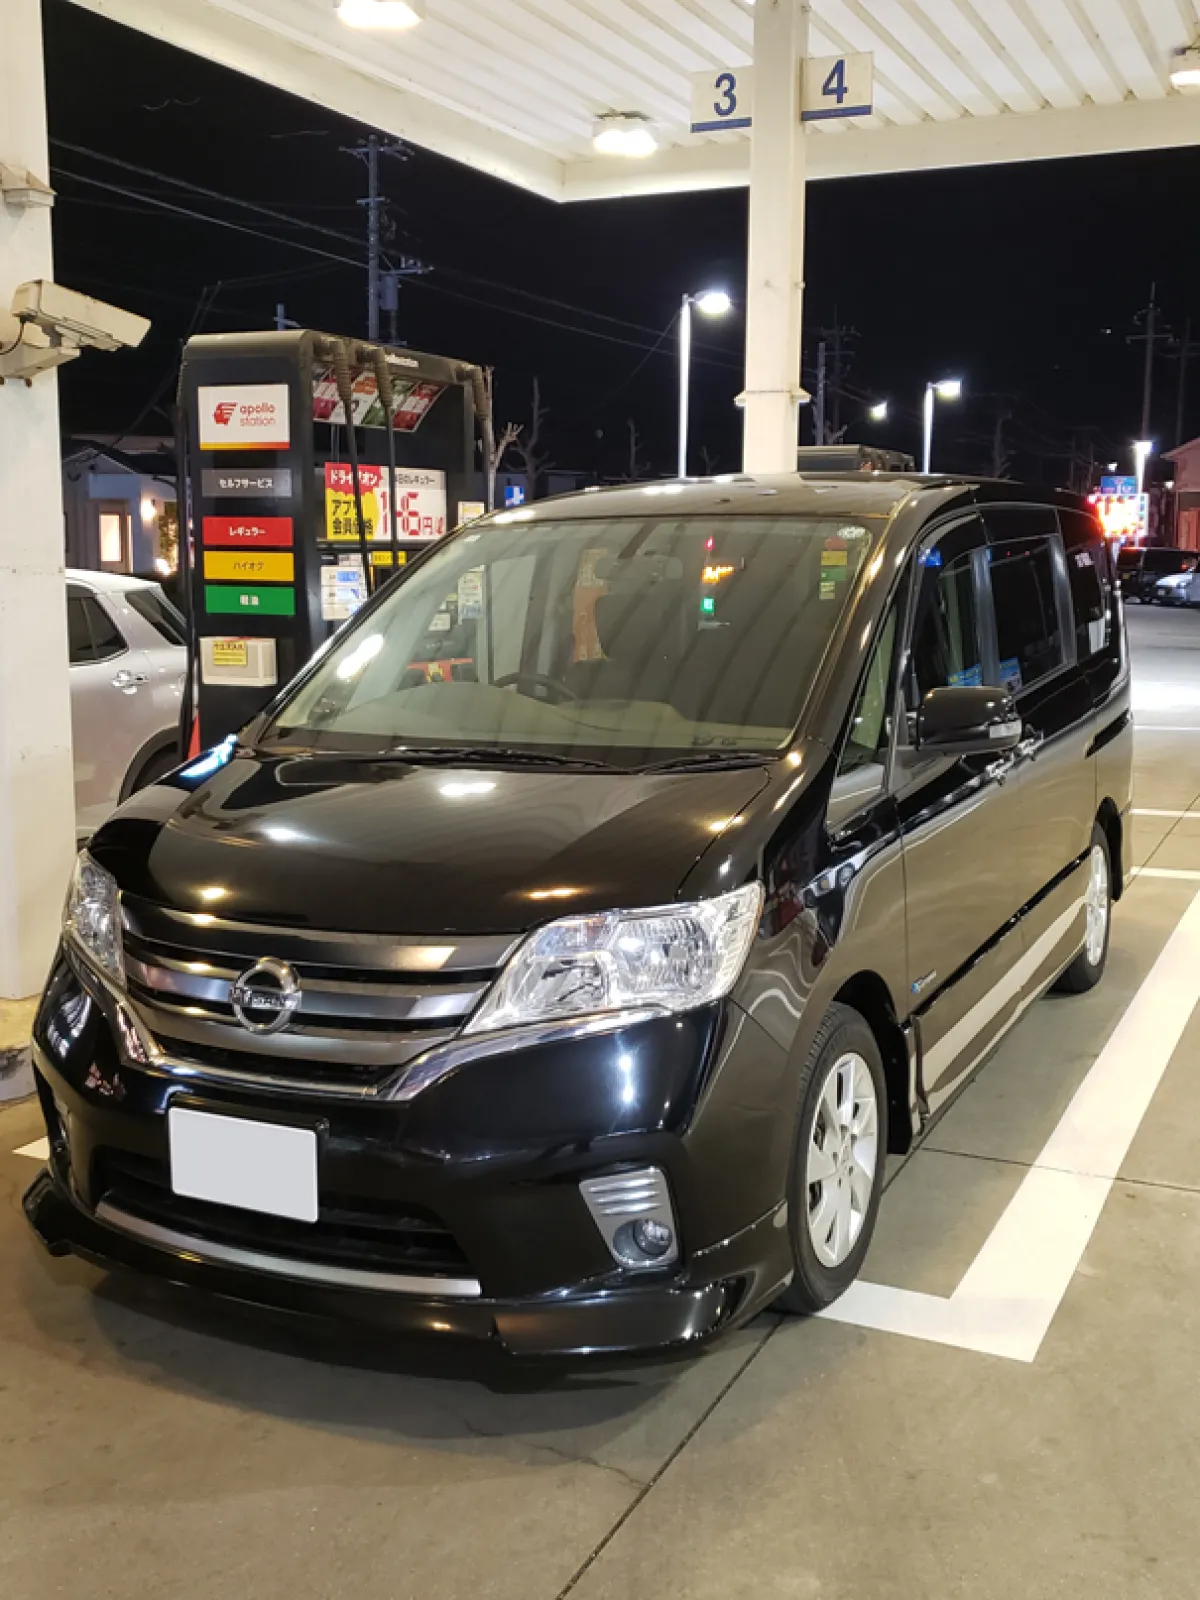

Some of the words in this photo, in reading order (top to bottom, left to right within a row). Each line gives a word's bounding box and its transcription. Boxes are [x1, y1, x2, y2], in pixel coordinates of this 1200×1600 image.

[821, 59, 848, 104] 4
[713, 72, 736, 117] 3
[239, 402, 276, 416] apollo
[239, 416, 277, 427] station
[219, 477, 273, 489] セルフサービス
[229, 526, 267, 537] レギュラー
[233, 561, 265, 572] ハイオク
